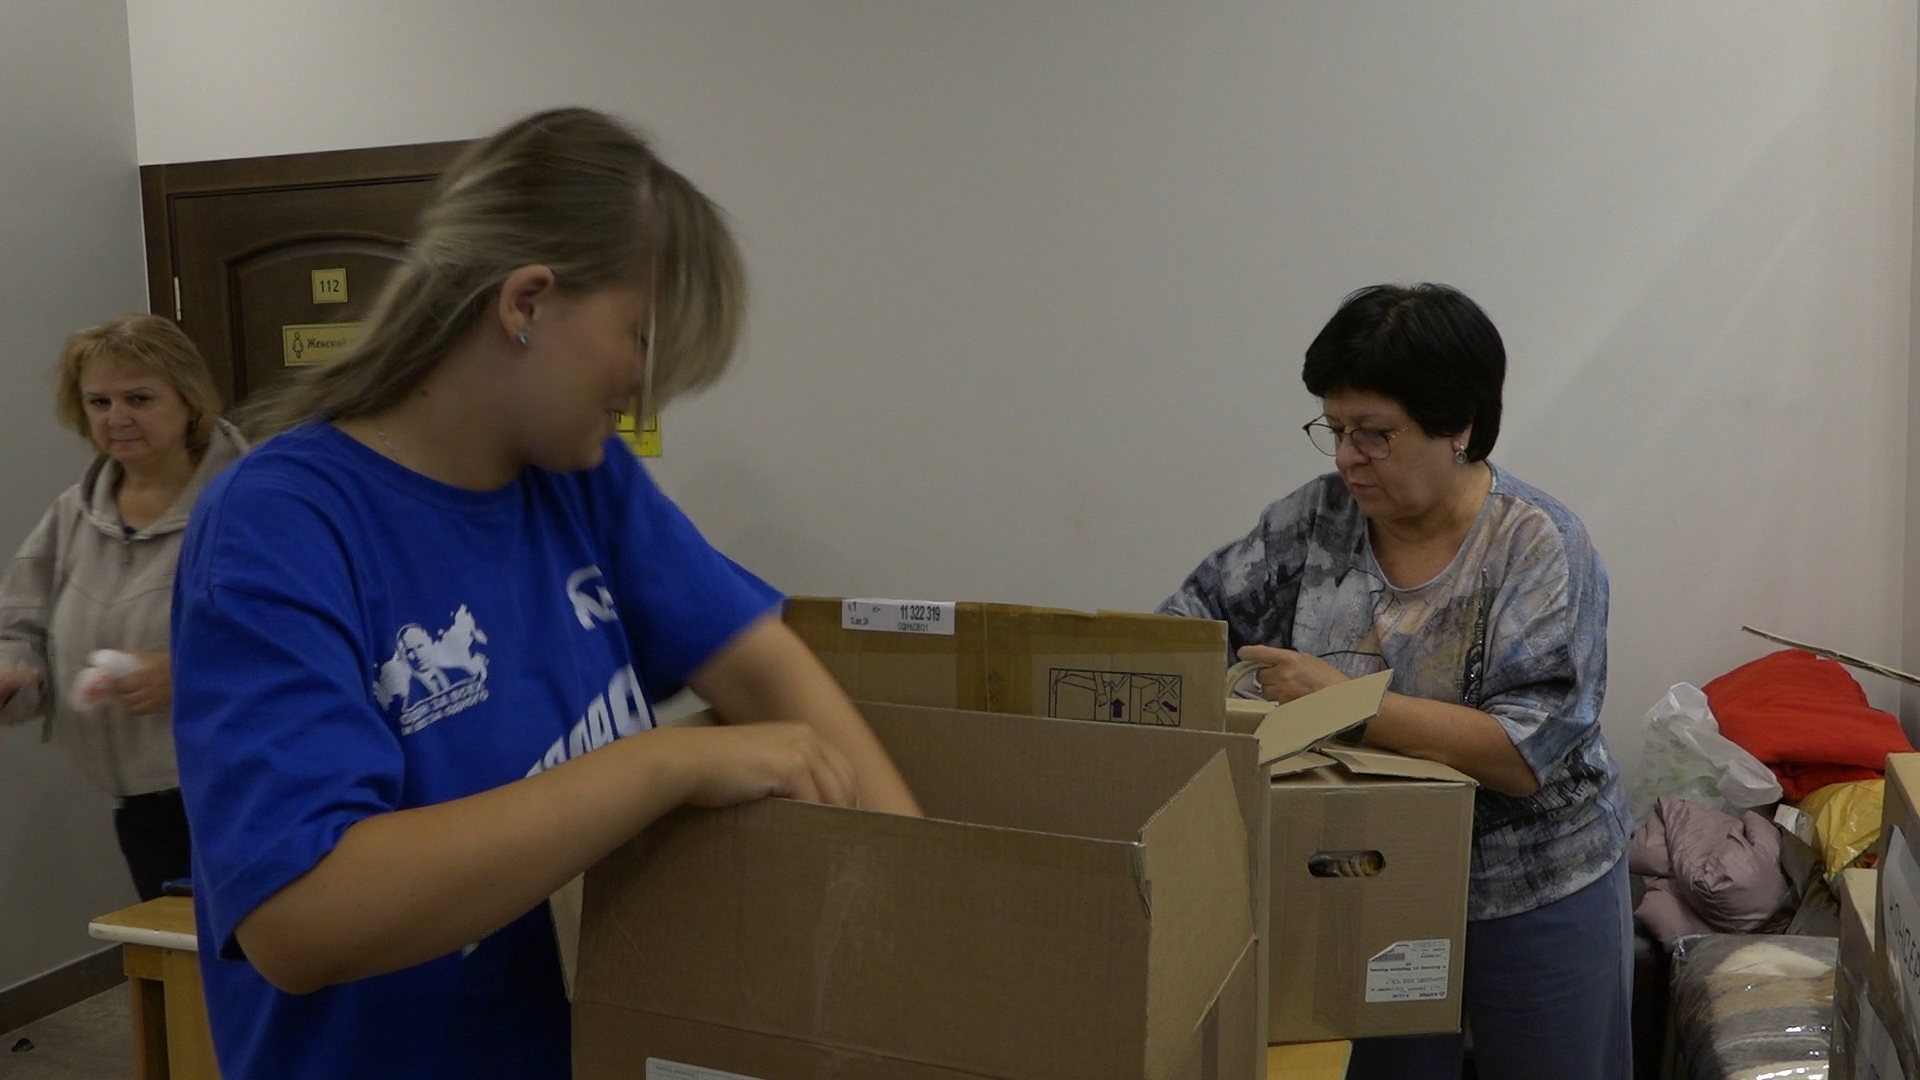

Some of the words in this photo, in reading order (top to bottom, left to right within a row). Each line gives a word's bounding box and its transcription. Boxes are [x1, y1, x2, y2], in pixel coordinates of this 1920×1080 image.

[320, 279, 340, 293] 112
[910, 604, 925, 621] 322
[926, 605, 941, 622] 319
